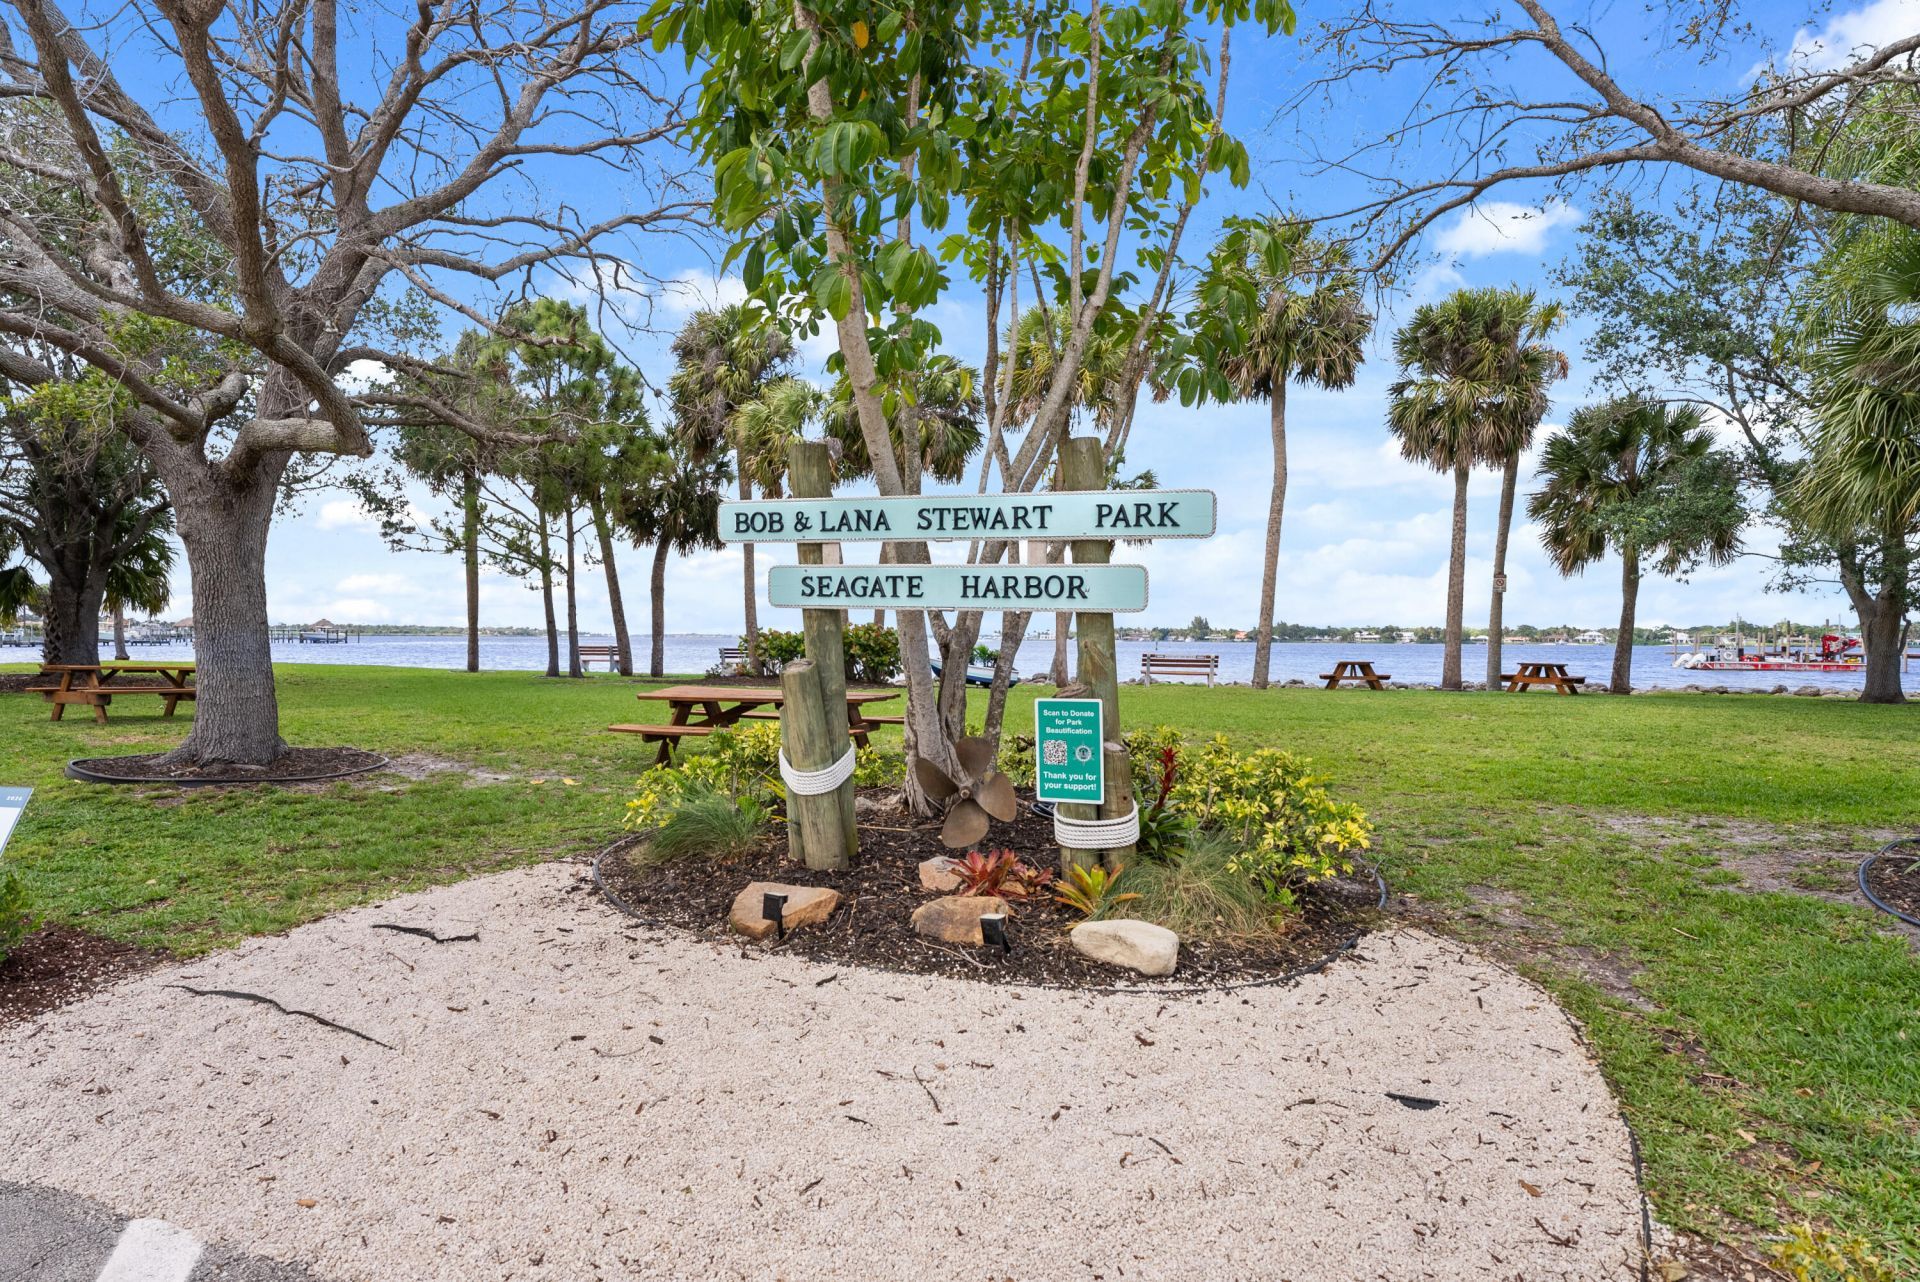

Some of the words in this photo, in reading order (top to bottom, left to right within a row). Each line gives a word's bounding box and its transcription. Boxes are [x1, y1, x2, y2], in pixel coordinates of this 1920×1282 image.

[735, 511, 784, 533] BOB
[794, 511, 812, 533] &
[820, 509, 891, 532] LANA
[918, 505, 1052, 530] STEWART
[1095, 502, 1181, 528] PARK
[801, 575, 924, 598] SEAGATE
[961, 574, 1089, 599] HARBOR
[1044, 782, 1061, 790] your
[1064, 782, 1096, 791] support!
